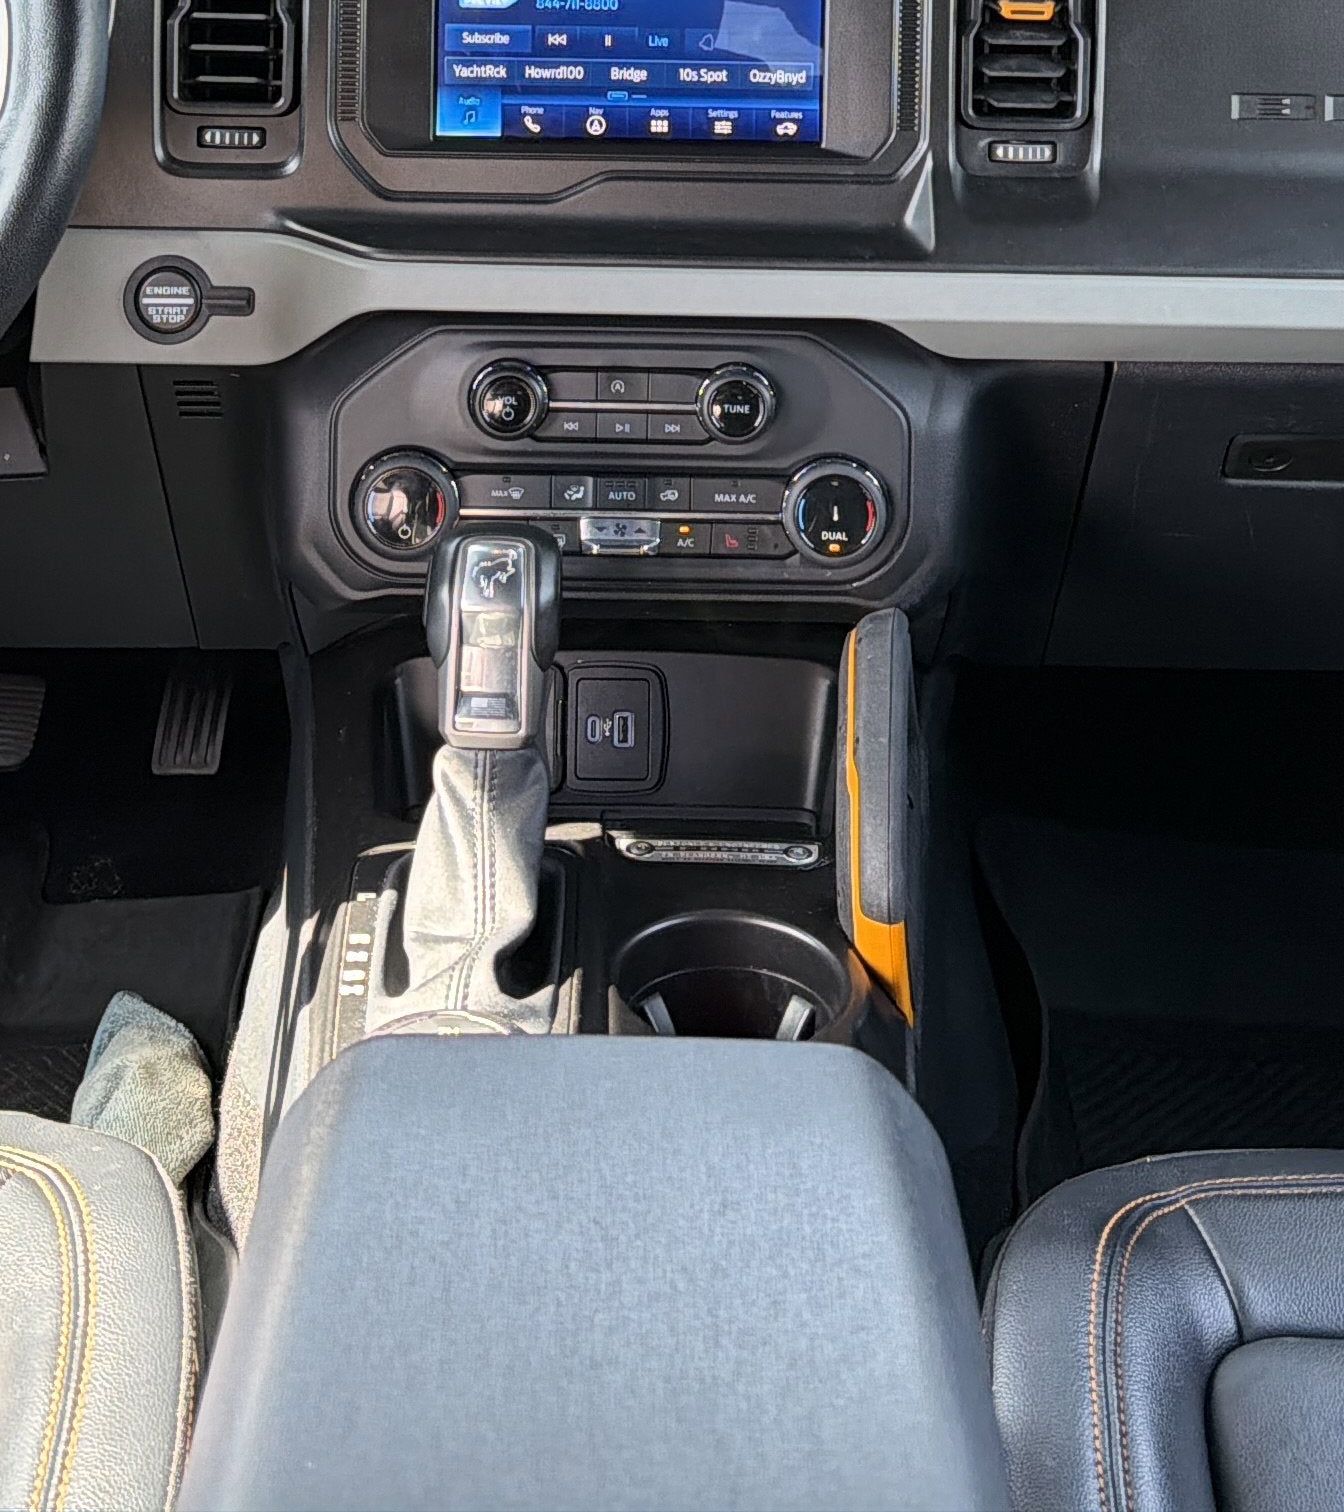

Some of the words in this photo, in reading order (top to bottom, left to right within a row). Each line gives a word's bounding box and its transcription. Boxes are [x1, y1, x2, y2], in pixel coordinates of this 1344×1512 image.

[462, 32, 510, 44] Subscribe
[648, 35, 669, 47] Live
[453, 65, 507, 79] YachtRck
[525, 65, 584, 80] Howrd100
[610, 67, 647, 83] Bridge
[679, 68, 698, 82] 10s
[699, 68, 728, 84] Spot
[749, 69, 807, 85] OzzyBnyd
[458, 96, 481, 106] Audio
[521, 106, 544, 114] Phone
[589, 106, 603, 115] Nav
[650, 108, 669, 117] Apps
[708, 109, 739, 119] Settings
[771, 110, 803, 120] Features
[146, 286, 191, 295] ENGINE
[147, 306, 188, 315] START
[152, 314, 185, 323] STOP
[724, 403, 751, 414] TUNE
[608, 491, 636, 501] AUTO
[714, 492, 733, 503] MAX
[735, 493, 757, 503] A/C
[821, 531, 849, 542] DUAL
[676, 538, 695, 548] A/C
